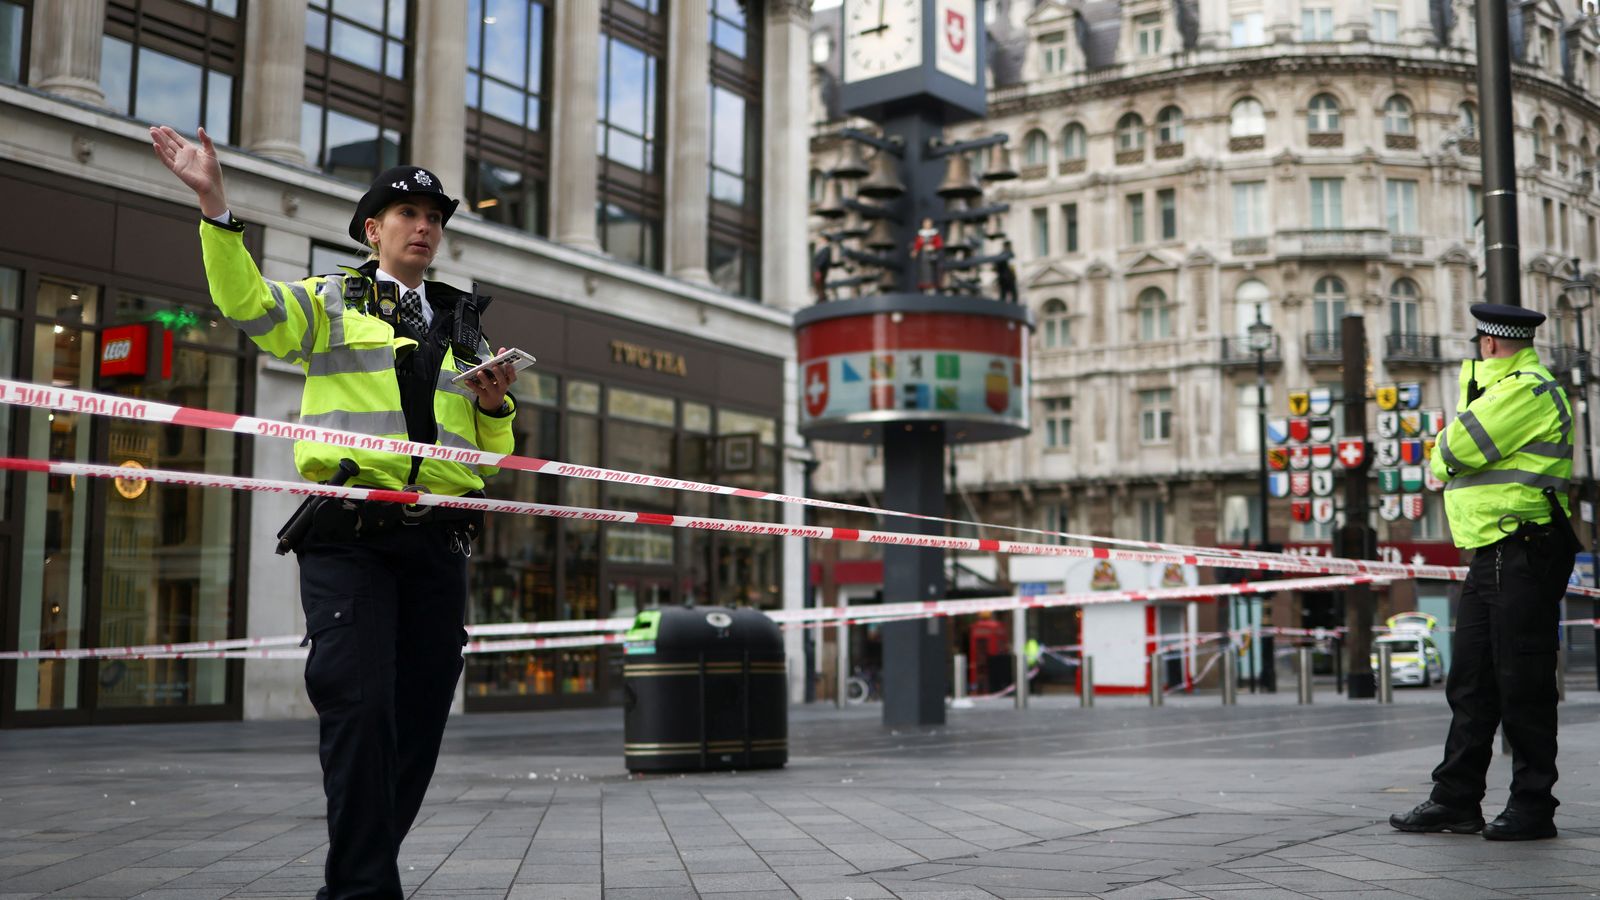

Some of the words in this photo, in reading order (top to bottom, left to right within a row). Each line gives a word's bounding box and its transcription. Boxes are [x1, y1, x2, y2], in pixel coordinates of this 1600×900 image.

[103, 339, 131, 361] LEGO
[611, 339, 651, 369] TWG
[653, 350, 688, 378] TEA
